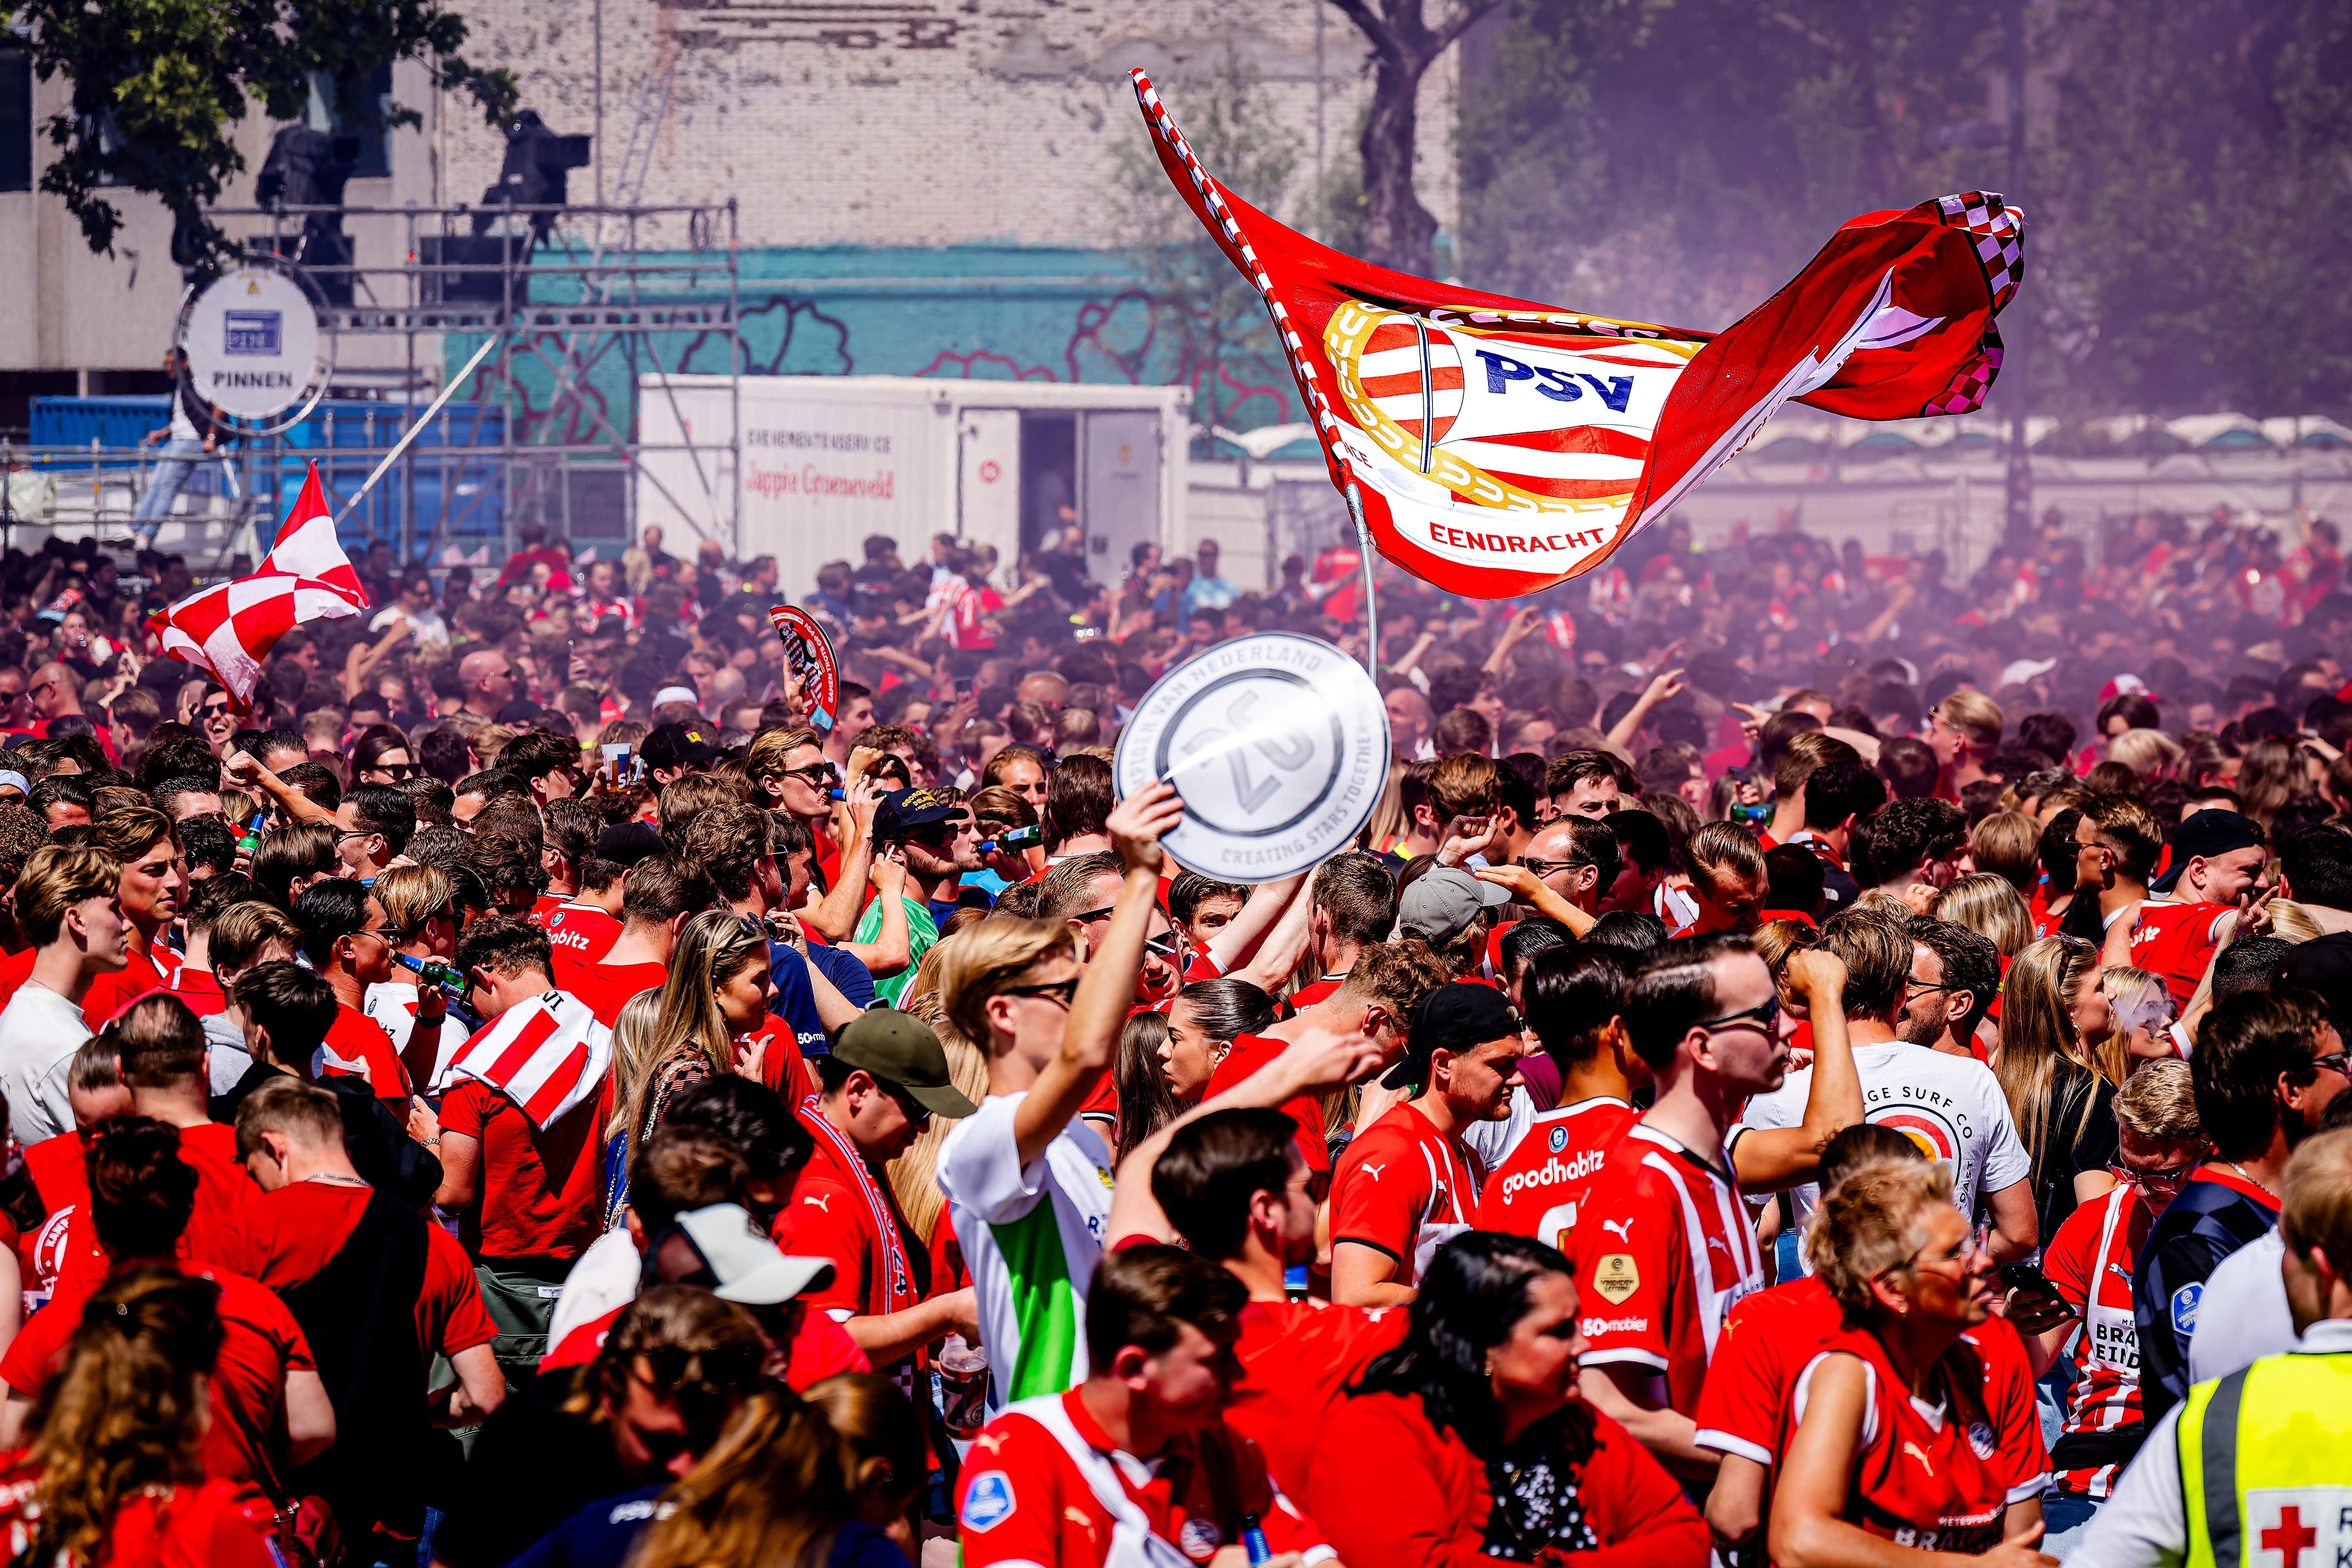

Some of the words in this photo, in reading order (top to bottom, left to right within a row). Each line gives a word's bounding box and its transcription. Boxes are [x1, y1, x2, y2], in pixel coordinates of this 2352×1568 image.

[212, 372, 293, 388] PINNEN
[1475, 349, 1634, 413] PSV
[746, 460, 797, 500] Jappie
[1430, 522, 1604, 553] EENDRACHT
[804, 623, 815, 637] PSV
[814, 635, 822, 647] OP
[820, 645, 832, 673] TROTS
[1151, 682, 1188, 716] VAN
[1191, 644, 1322, 682] NEDERLAND
[1221, 841, 1305, 865] CREATING
[1306, 805, 1349, 846] STARS
[1902, 1086, 1953, 1108] SURF
[1957, 1114, 1972, 1139] CO
[1503, 1149, 1604, 1205] goodhabitz
